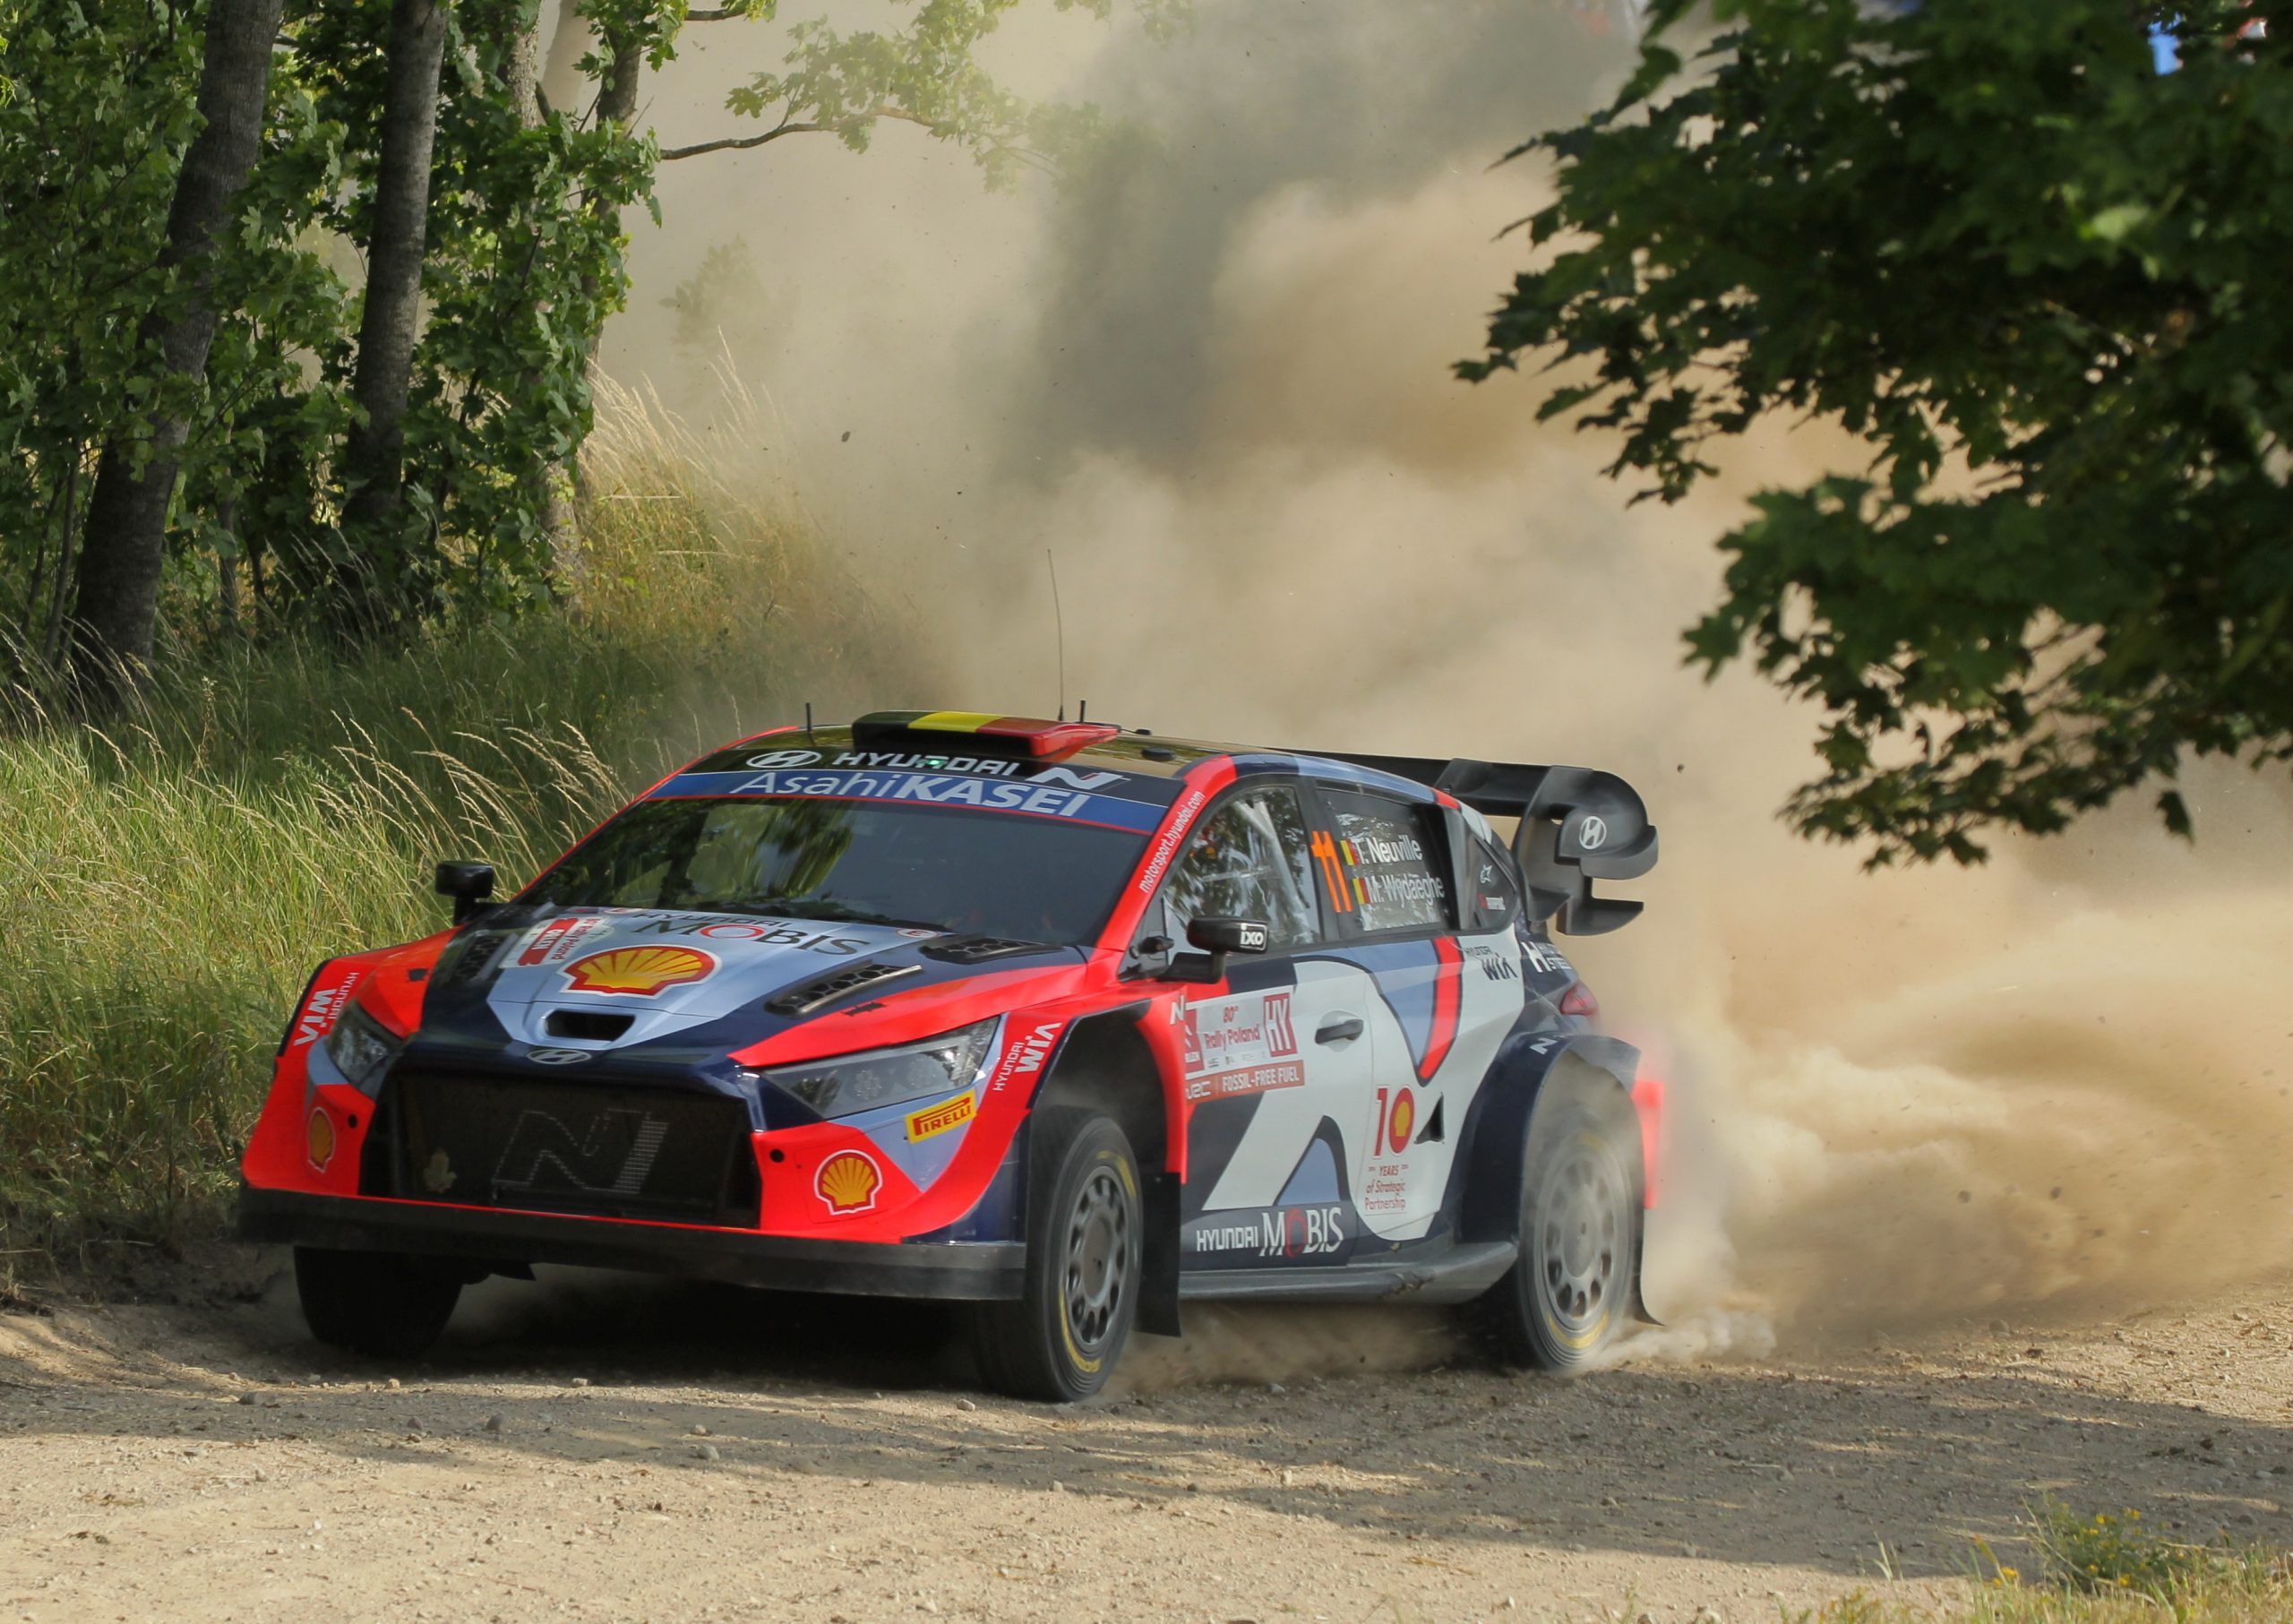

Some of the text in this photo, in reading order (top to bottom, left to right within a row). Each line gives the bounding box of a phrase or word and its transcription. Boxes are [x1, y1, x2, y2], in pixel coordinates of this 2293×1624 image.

[729, 771, 1092, 818] AsahiKASEI
[1310, 830, 1353, 914] 11
[1351, 834, 1423, 865] T. Neuville
[631, 919, 871, 956] MOBIS
[632, 912, 794, 928] HYUNDAI
[294, 988, 339, 1046] WIA
[327, 972, 360, 1020] HYUNDAI
[1013, 1021, 1062, 1073] WIA
[1203, 1023, 1261, 1053] Rally Poland
[992, 1041, 1026, 1092] HYUNDAI
[1223, 1067, 1276, 1093] FOSSIL-FREE
[1277, 1065, 1300, 1085] FUEL
[913, 1096, 972, 1137] PIRELLI
[1197, 1207, 1344, 1258] HYUNDAI MOBIS
